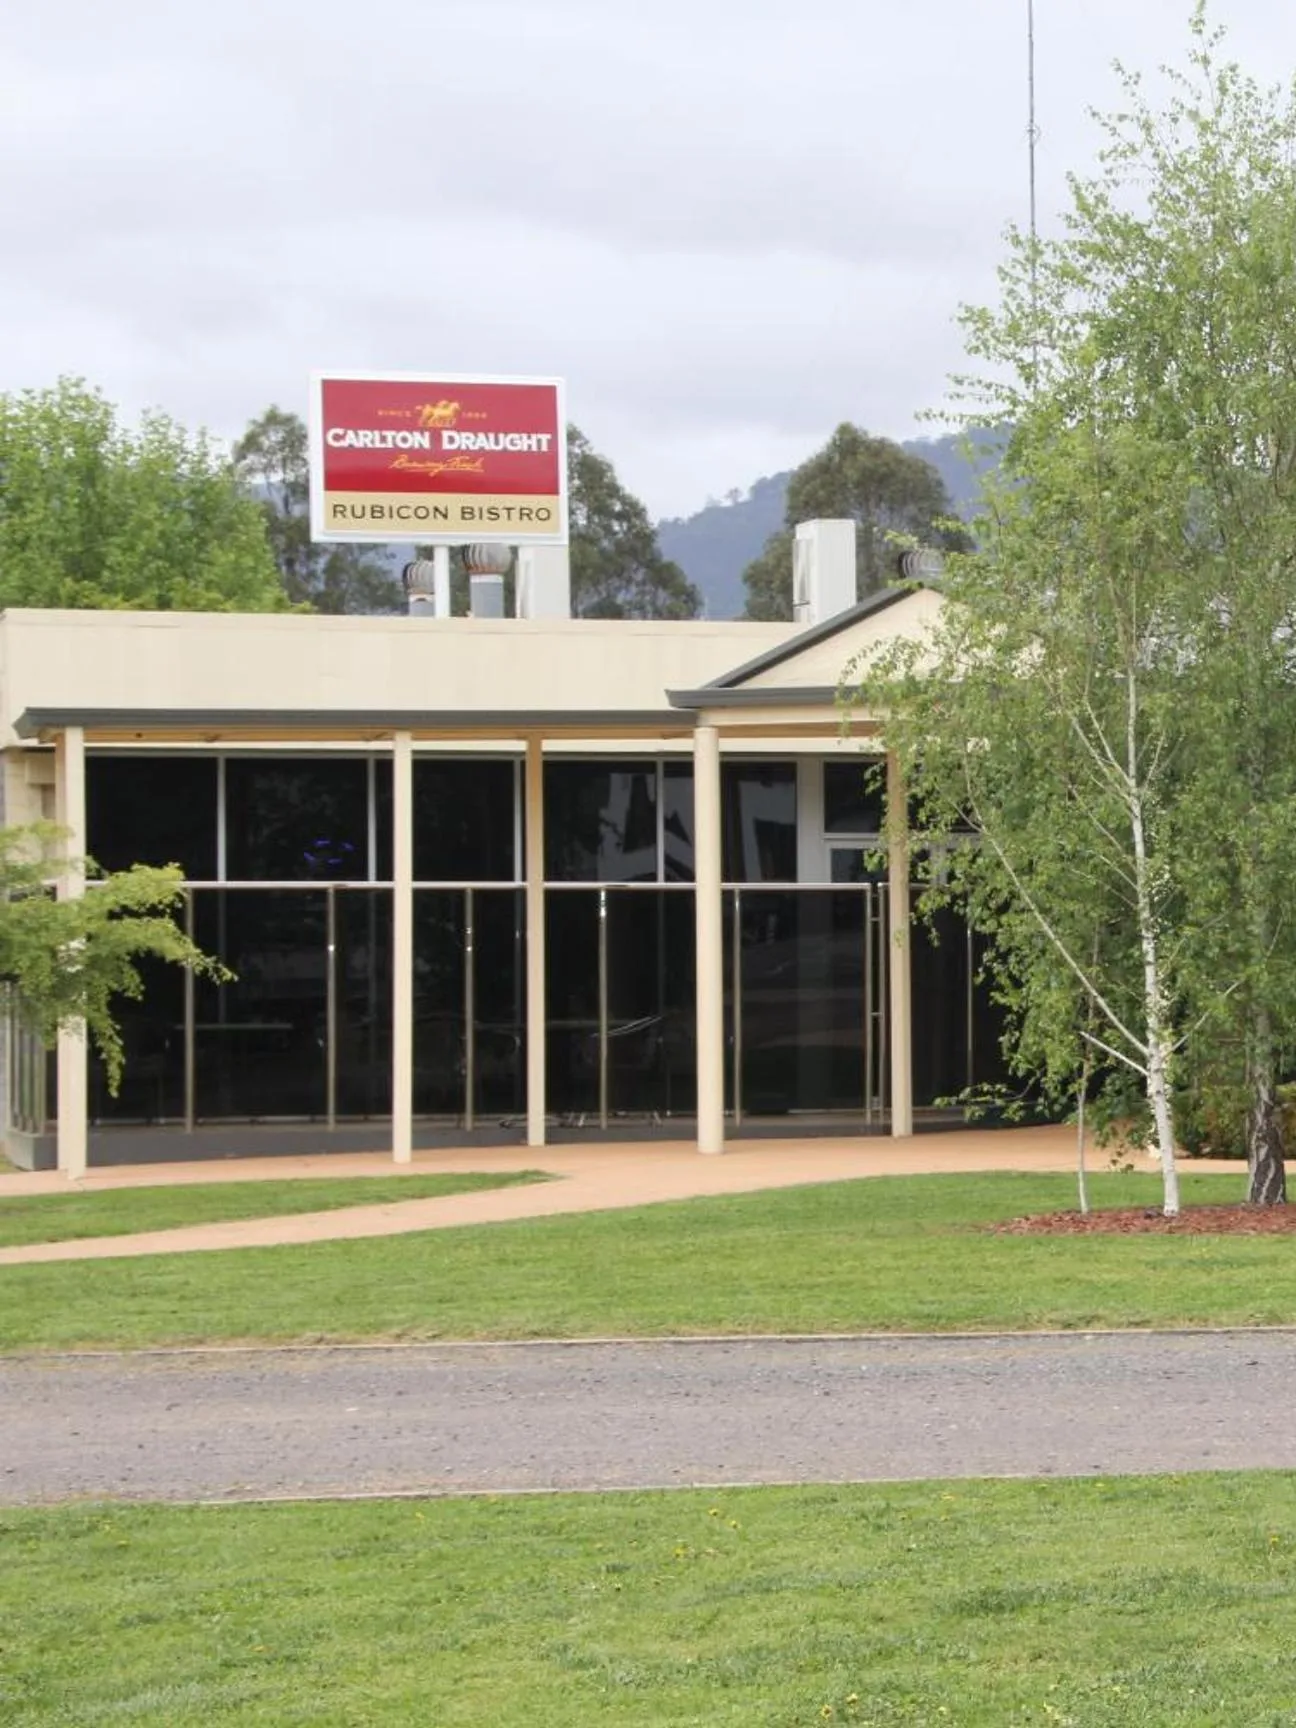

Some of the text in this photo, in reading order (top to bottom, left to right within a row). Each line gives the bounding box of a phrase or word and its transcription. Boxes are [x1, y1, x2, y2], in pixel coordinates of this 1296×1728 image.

[326, 428, 552, 452] CARLTON DRAUGHT
[332, 503, 551, 521] RUBICON BISTRO
